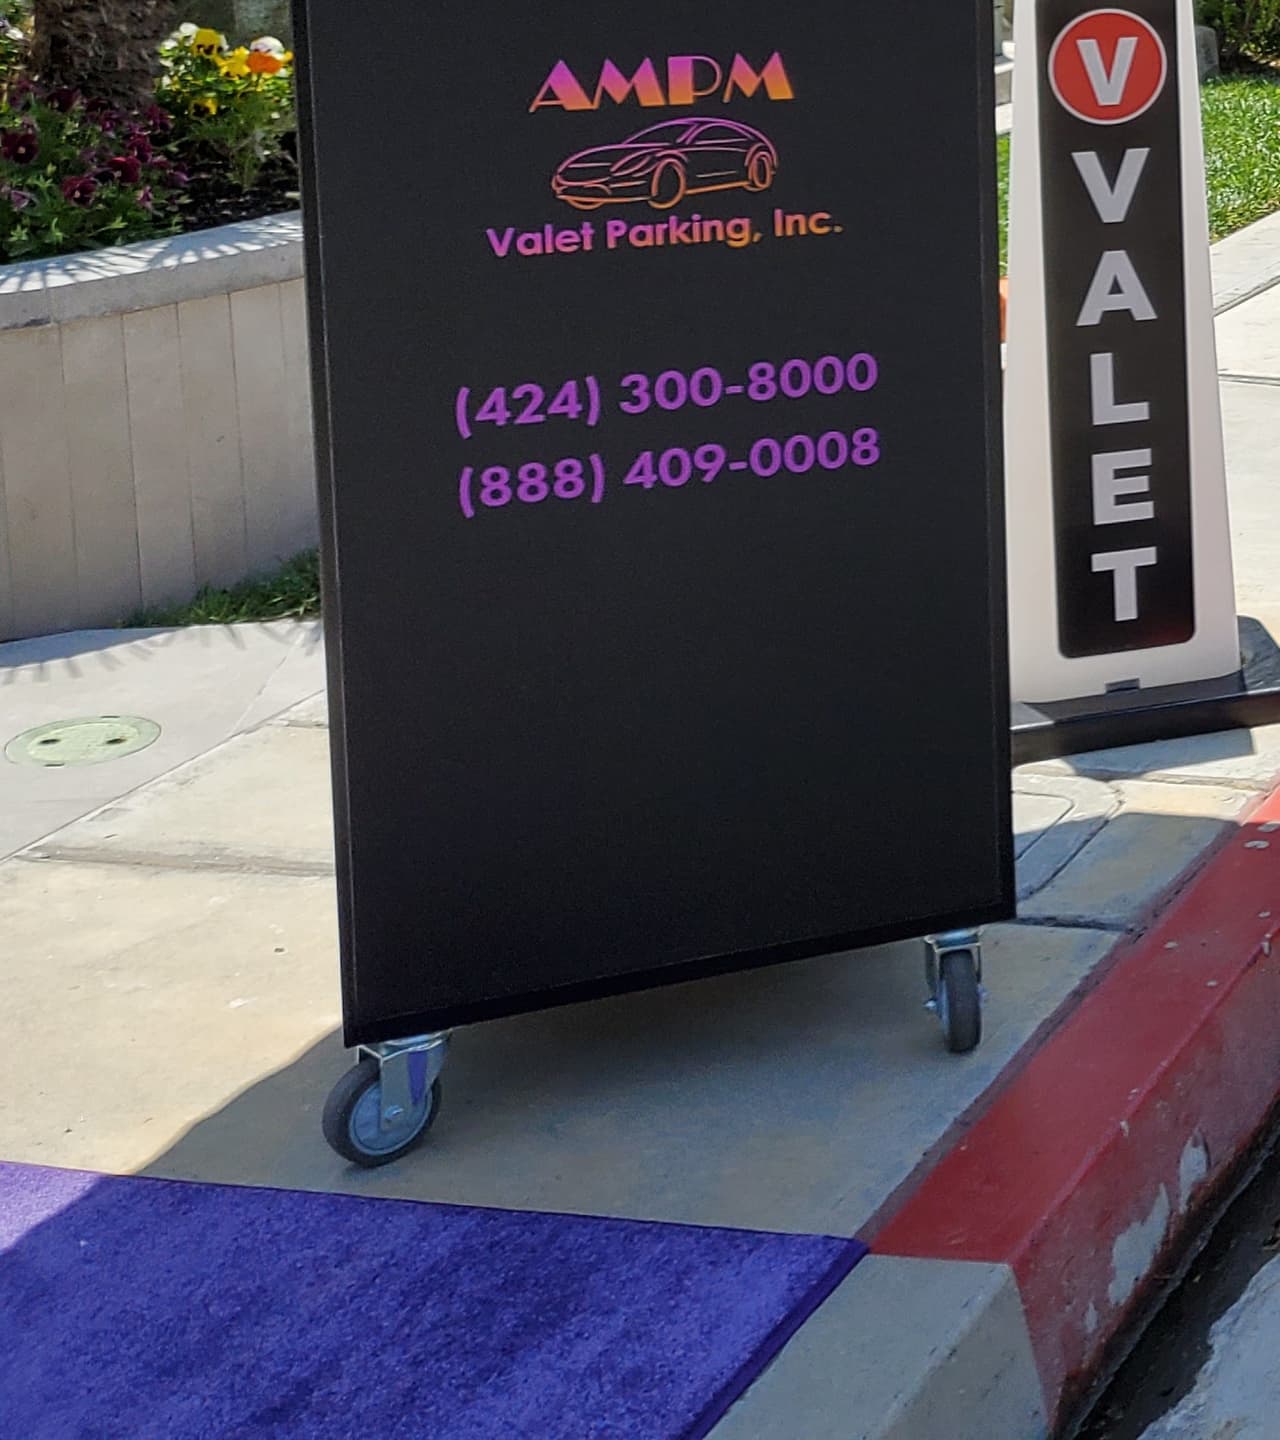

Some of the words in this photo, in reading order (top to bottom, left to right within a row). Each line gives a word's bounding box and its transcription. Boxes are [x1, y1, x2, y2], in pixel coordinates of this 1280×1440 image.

[529, 51, 795, 112] AMPM
[1076, 36, 1138, 107] V
[485, 221, 594, 257] Valet
[606, 212, 762, 248] Parking,
[774, 208, 843, 237] Inc.
[455, 376, 600, 439] (424)
[619, 352, 879, 414] 300-8000
[1071, 146, 1158, 623] VALET
[459, 454, 605, 519] (888)
[623, 427, 881, 489] 409-0008
